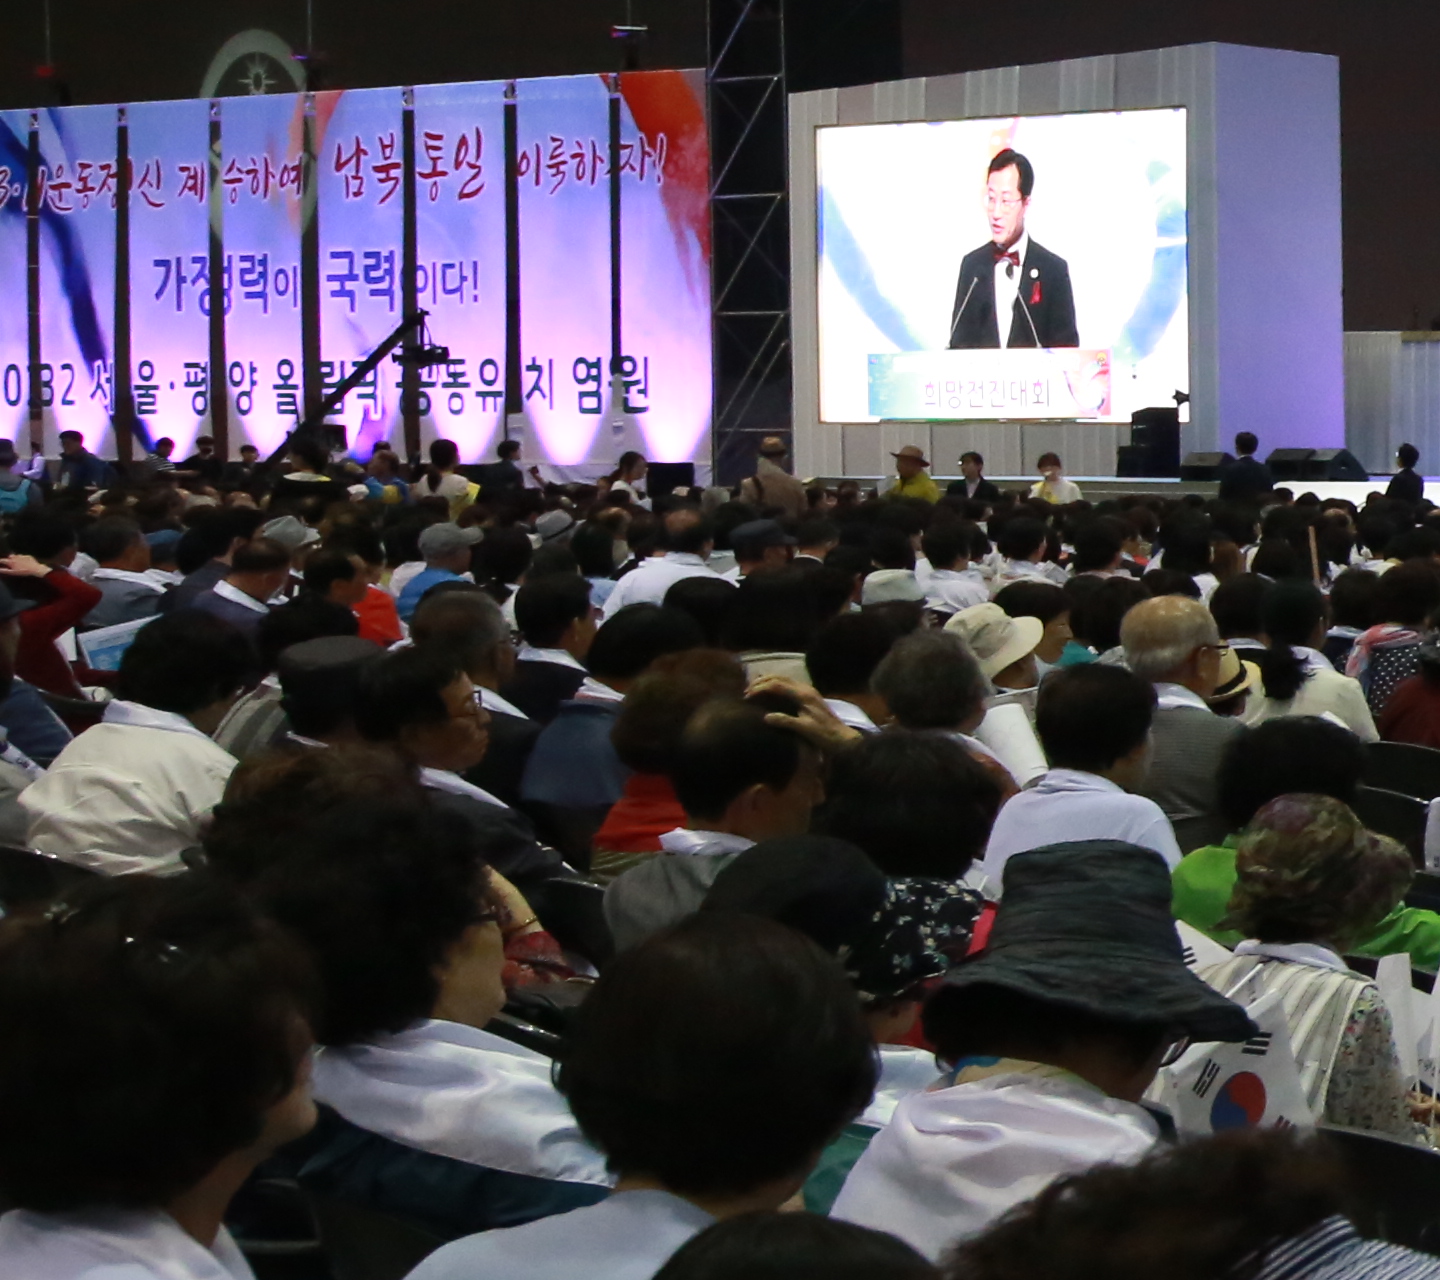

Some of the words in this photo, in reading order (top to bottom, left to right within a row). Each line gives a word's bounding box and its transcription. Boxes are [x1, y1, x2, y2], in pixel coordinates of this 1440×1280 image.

[334, 126, 484, 205] 남북통일
[153, 253, 299, 316] 가정력이
[326, 250, 480, 313] 국력이다!
[572, 355, 649, 414] 염원
[924, 378, 1050, 409] 희망전진대회
